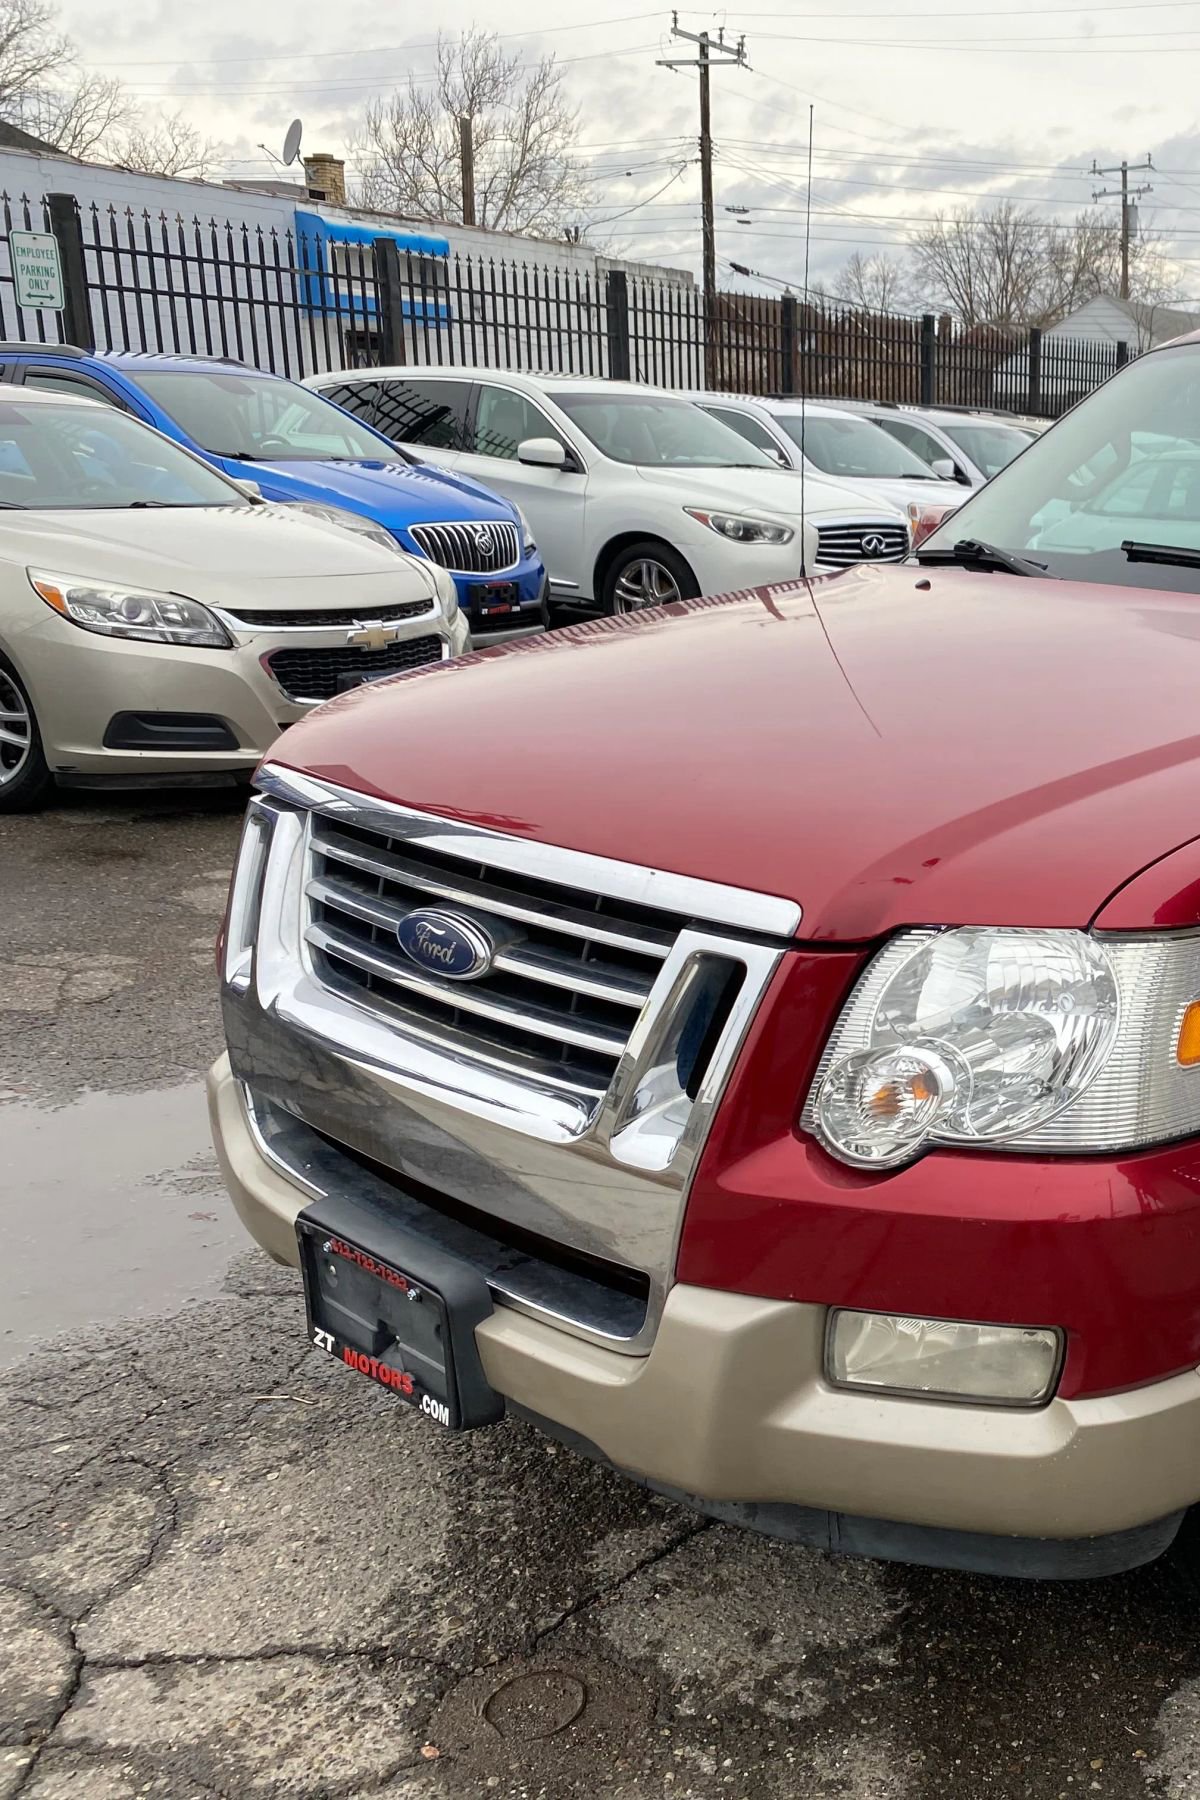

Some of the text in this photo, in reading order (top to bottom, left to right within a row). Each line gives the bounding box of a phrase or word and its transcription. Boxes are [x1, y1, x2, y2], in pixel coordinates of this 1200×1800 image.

[15, 246, 55, 261] EMPLOYEE
[20, 264, 56, 278] PARKING
[28, 278, 50, 291] ONLY
[409, 921, 456, 965] Ford
[312, 1326, 450, 1427] ZT MOTORS .COM
